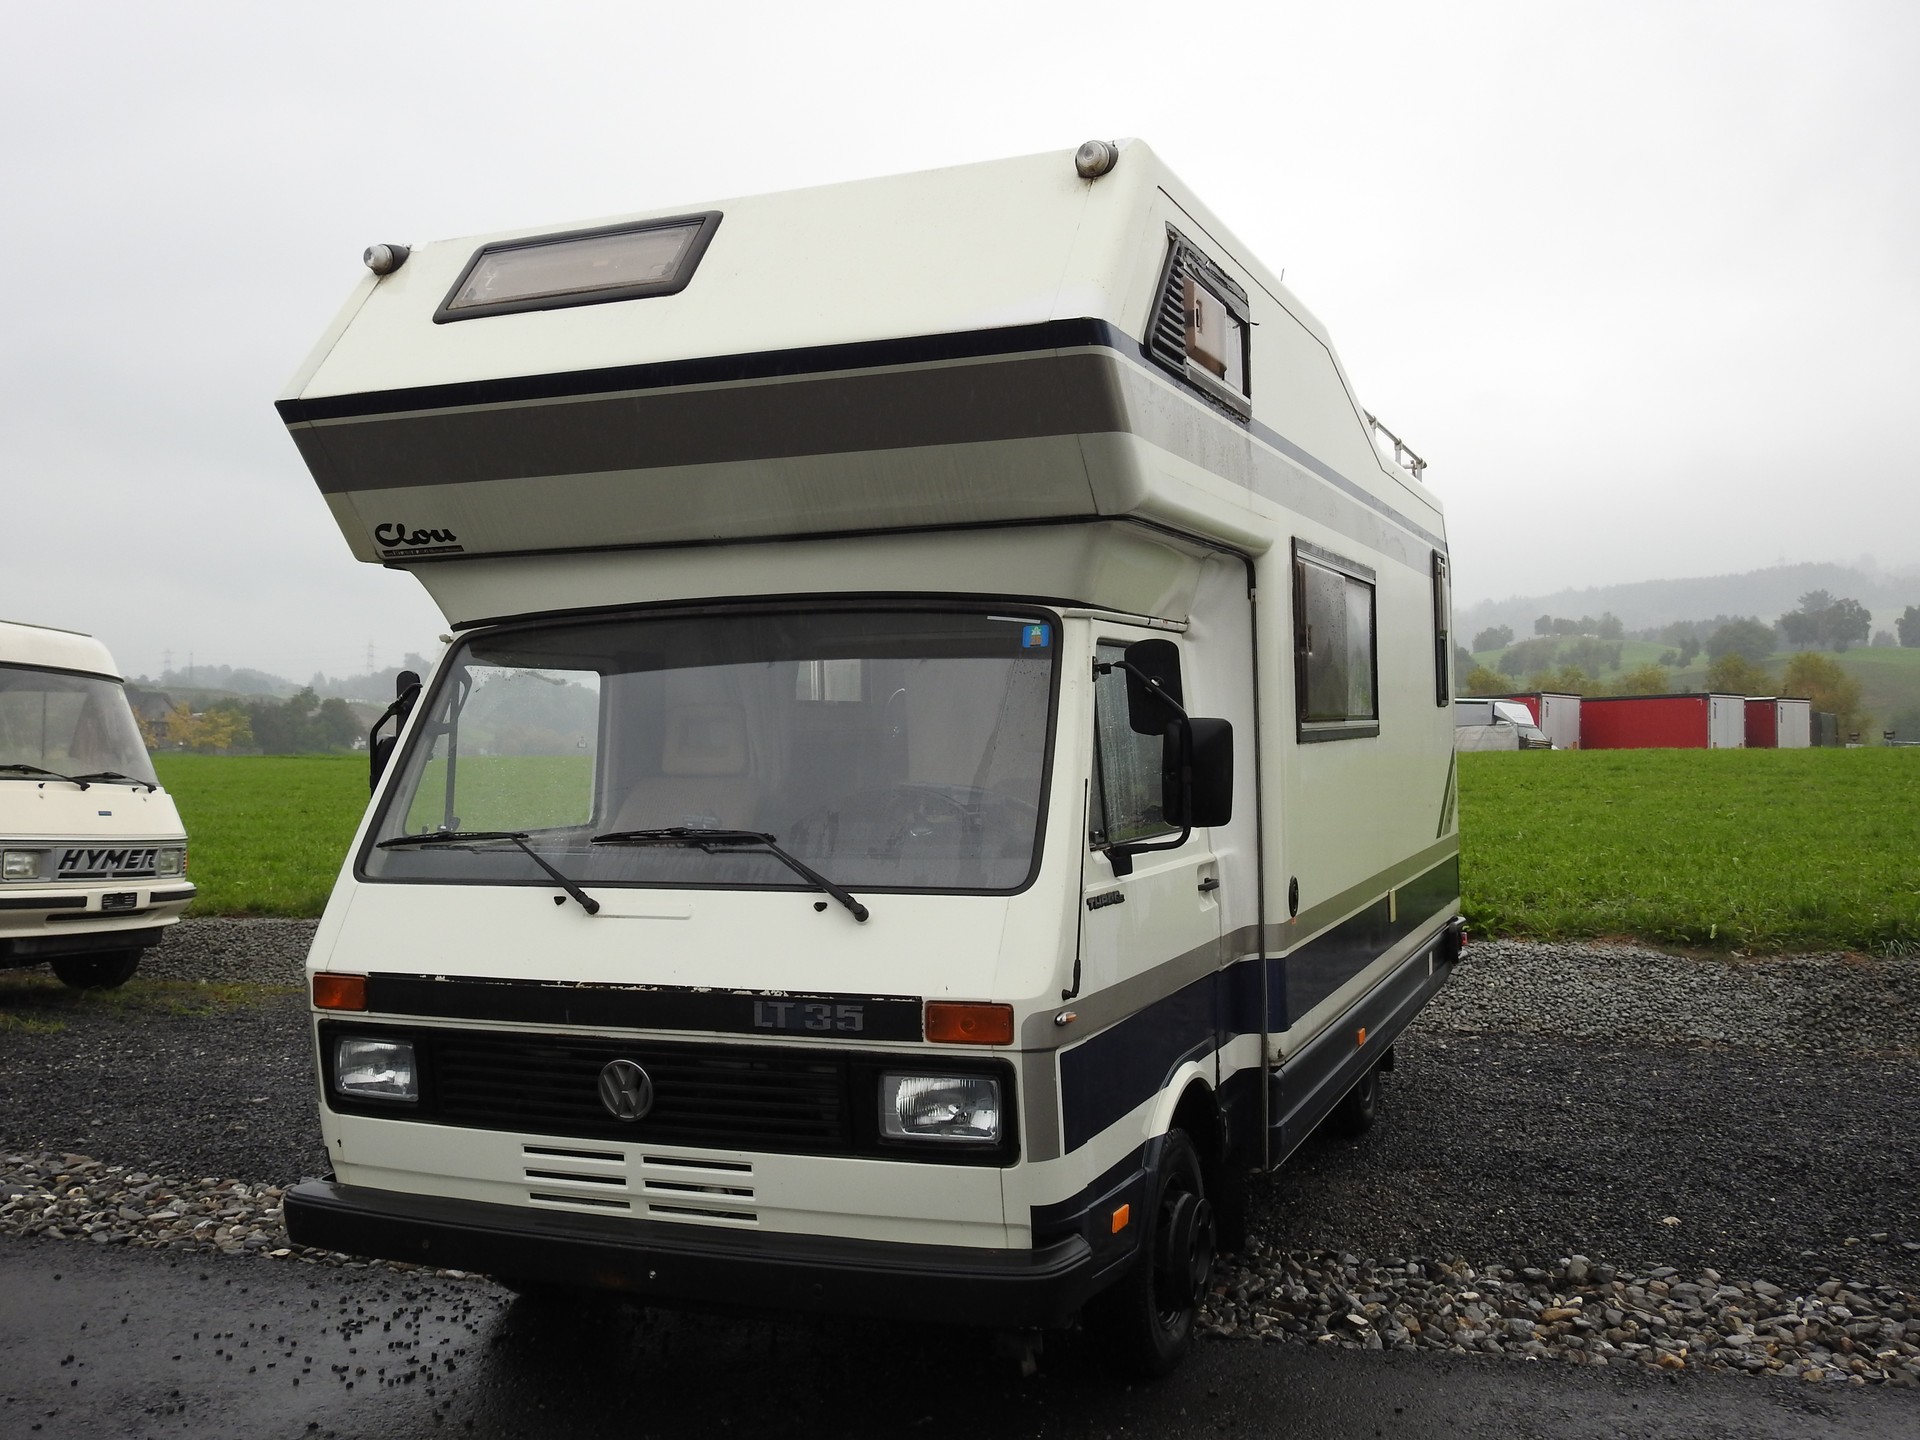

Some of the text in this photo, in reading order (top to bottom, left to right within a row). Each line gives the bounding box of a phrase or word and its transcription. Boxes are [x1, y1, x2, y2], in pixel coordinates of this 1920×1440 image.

[375, 523, 457, 547] Clou
[58, 848, 159, 870] HYMER
[753, 1001, 864, 1032] LT 35
